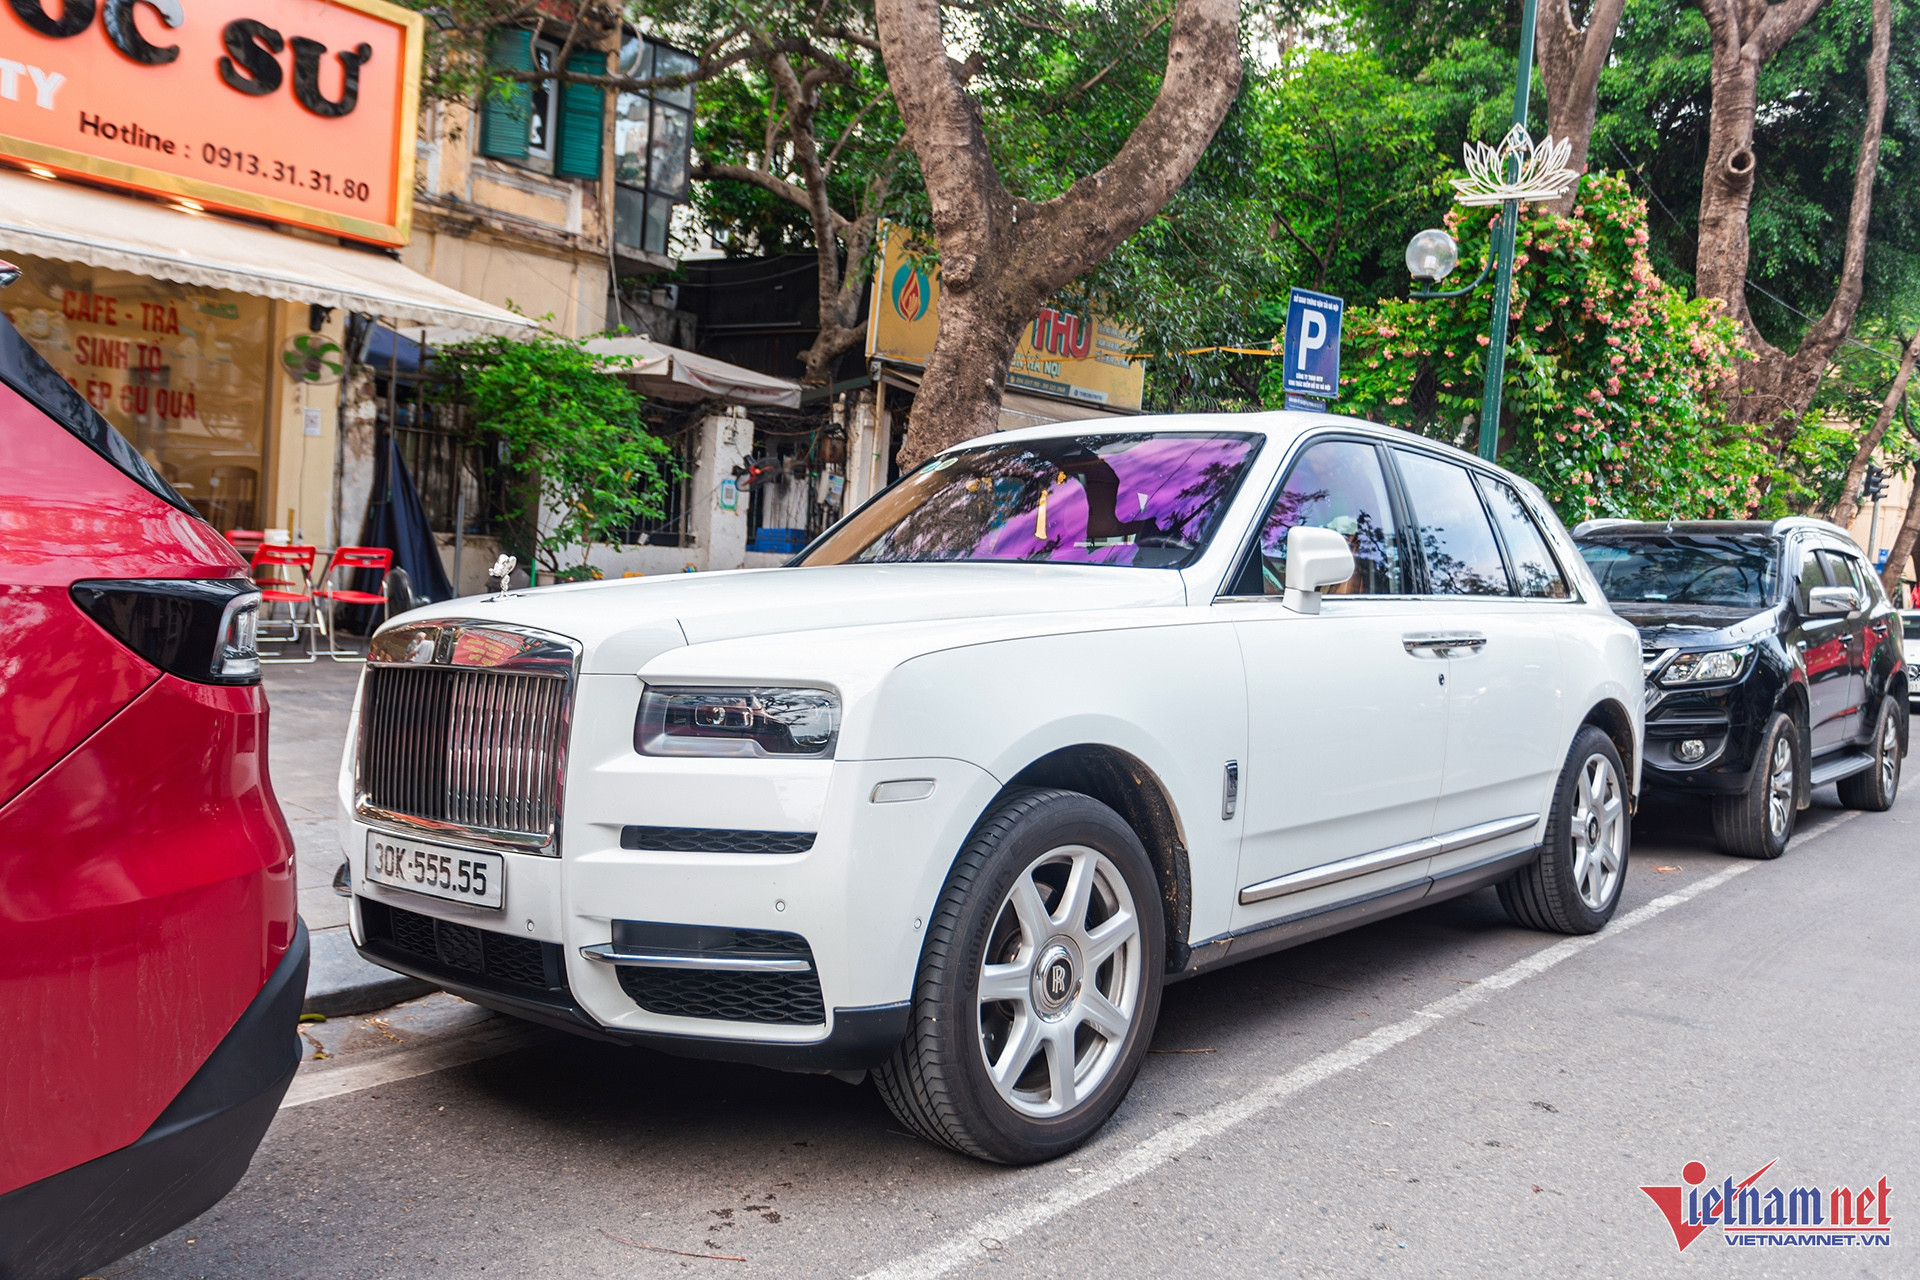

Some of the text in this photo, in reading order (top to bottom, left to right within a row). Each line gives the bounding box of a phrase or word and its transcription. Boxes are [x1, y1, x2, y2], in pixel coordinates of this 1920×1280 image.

[79, 110, 176, 155] Hotline
[202, 142, 370, 203] 0913.31.31.80
[62, 290, 117, 327] CAFE
[75, 335, 129, 371] SINH
[1297, 309, 1327, 370] P
